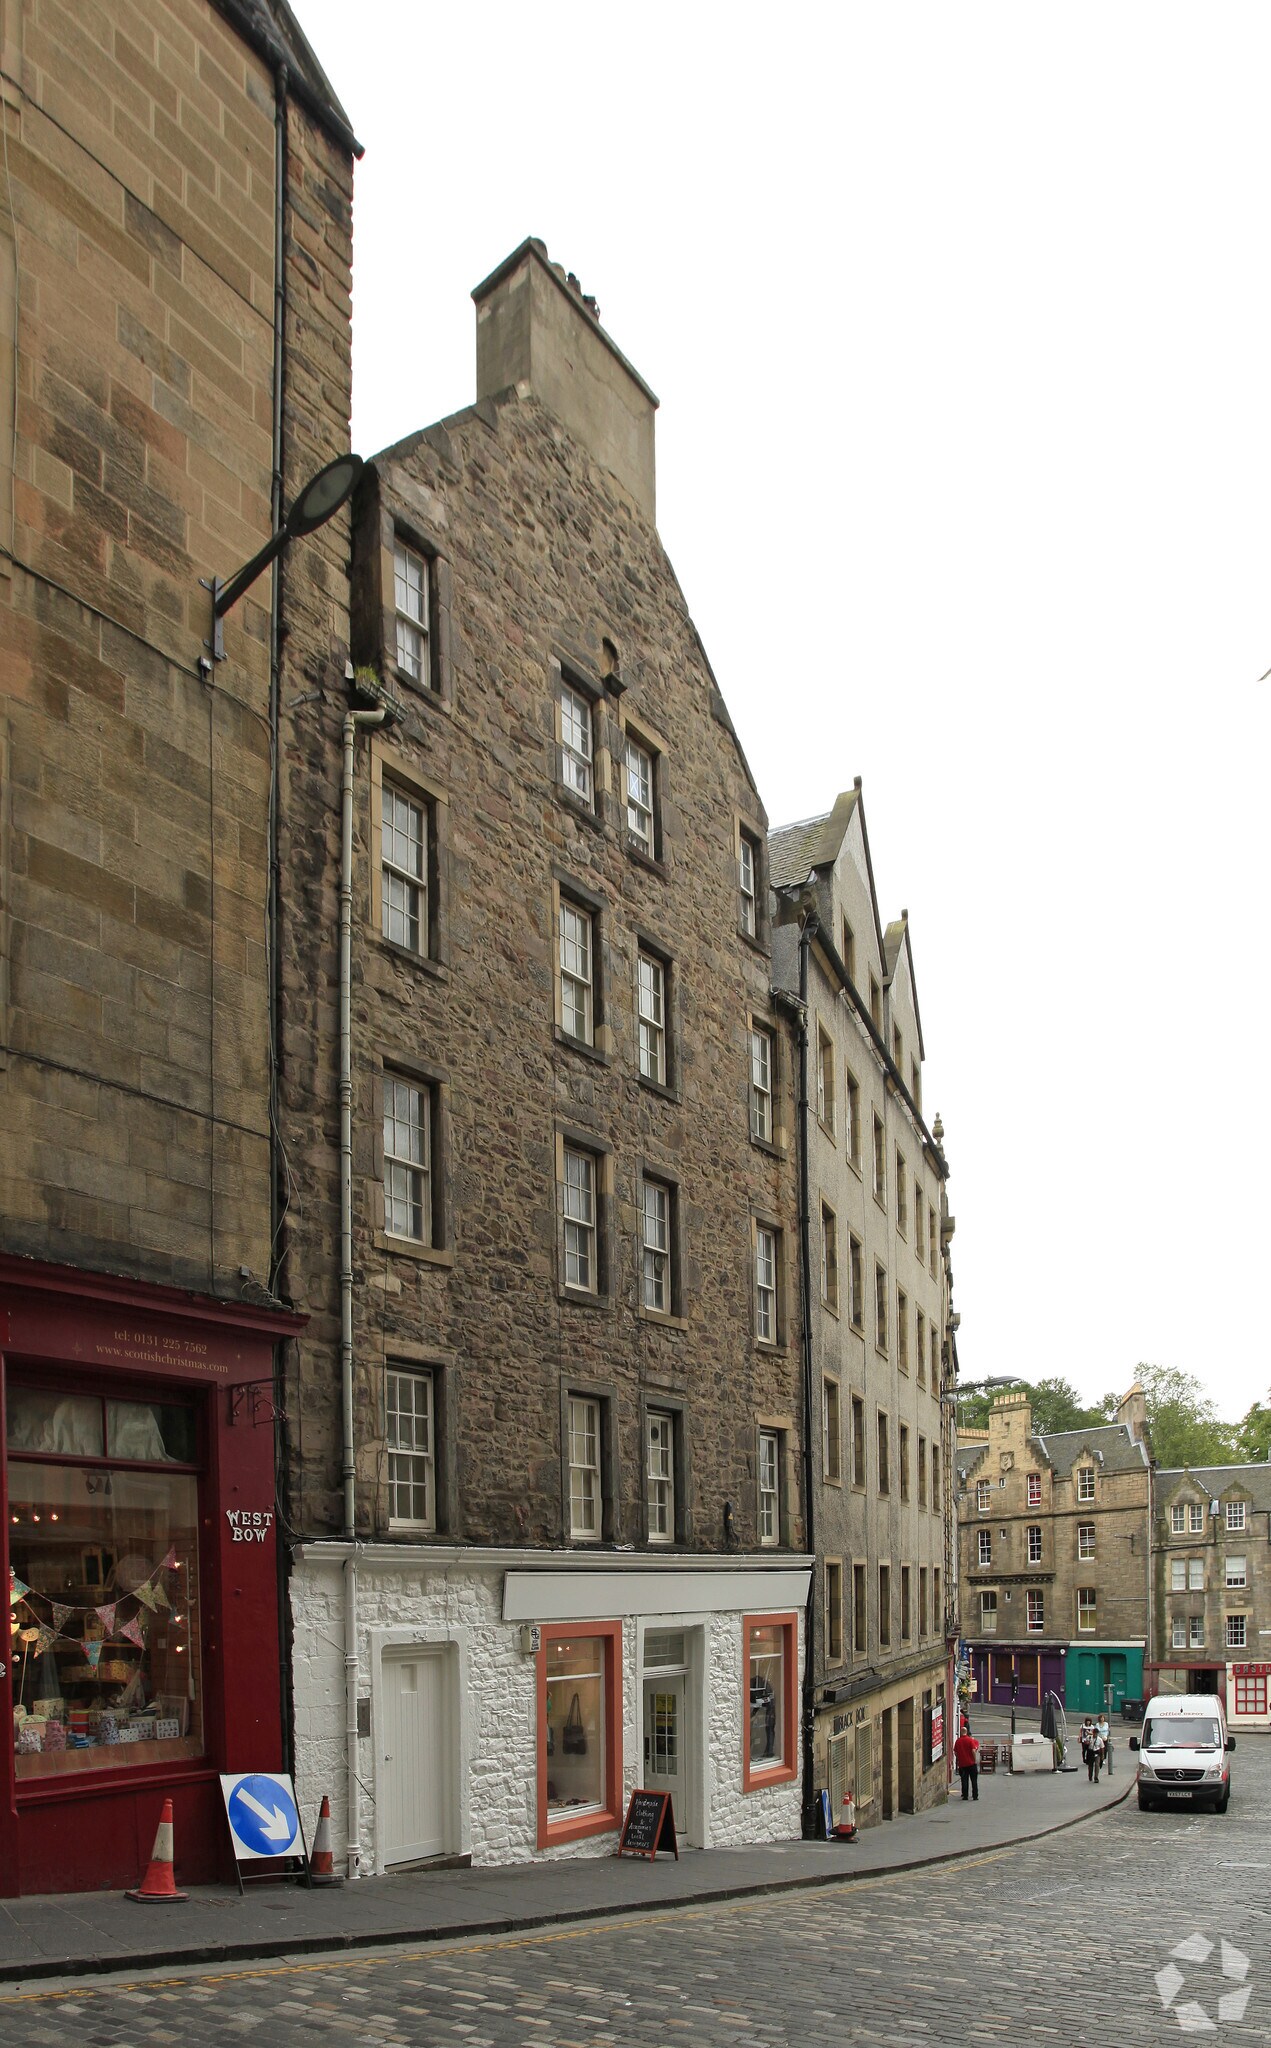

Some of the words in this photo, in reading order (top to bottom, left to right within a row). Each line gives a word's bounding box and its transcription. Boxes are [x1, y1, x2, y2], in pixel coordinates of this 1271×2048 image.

[114, 1330, 130, 1341] tel:
[134, 1333, 158, 1346] 0131
[162, 1337, 181, 1349] 225
[184, 1341, 207, 1354] 7562
[96, 1345, 229, 1373] www.scottishchristmas.com
[226, 1509, 273, 1526] WEST
[232, 1527, 267, 1542] BOW
